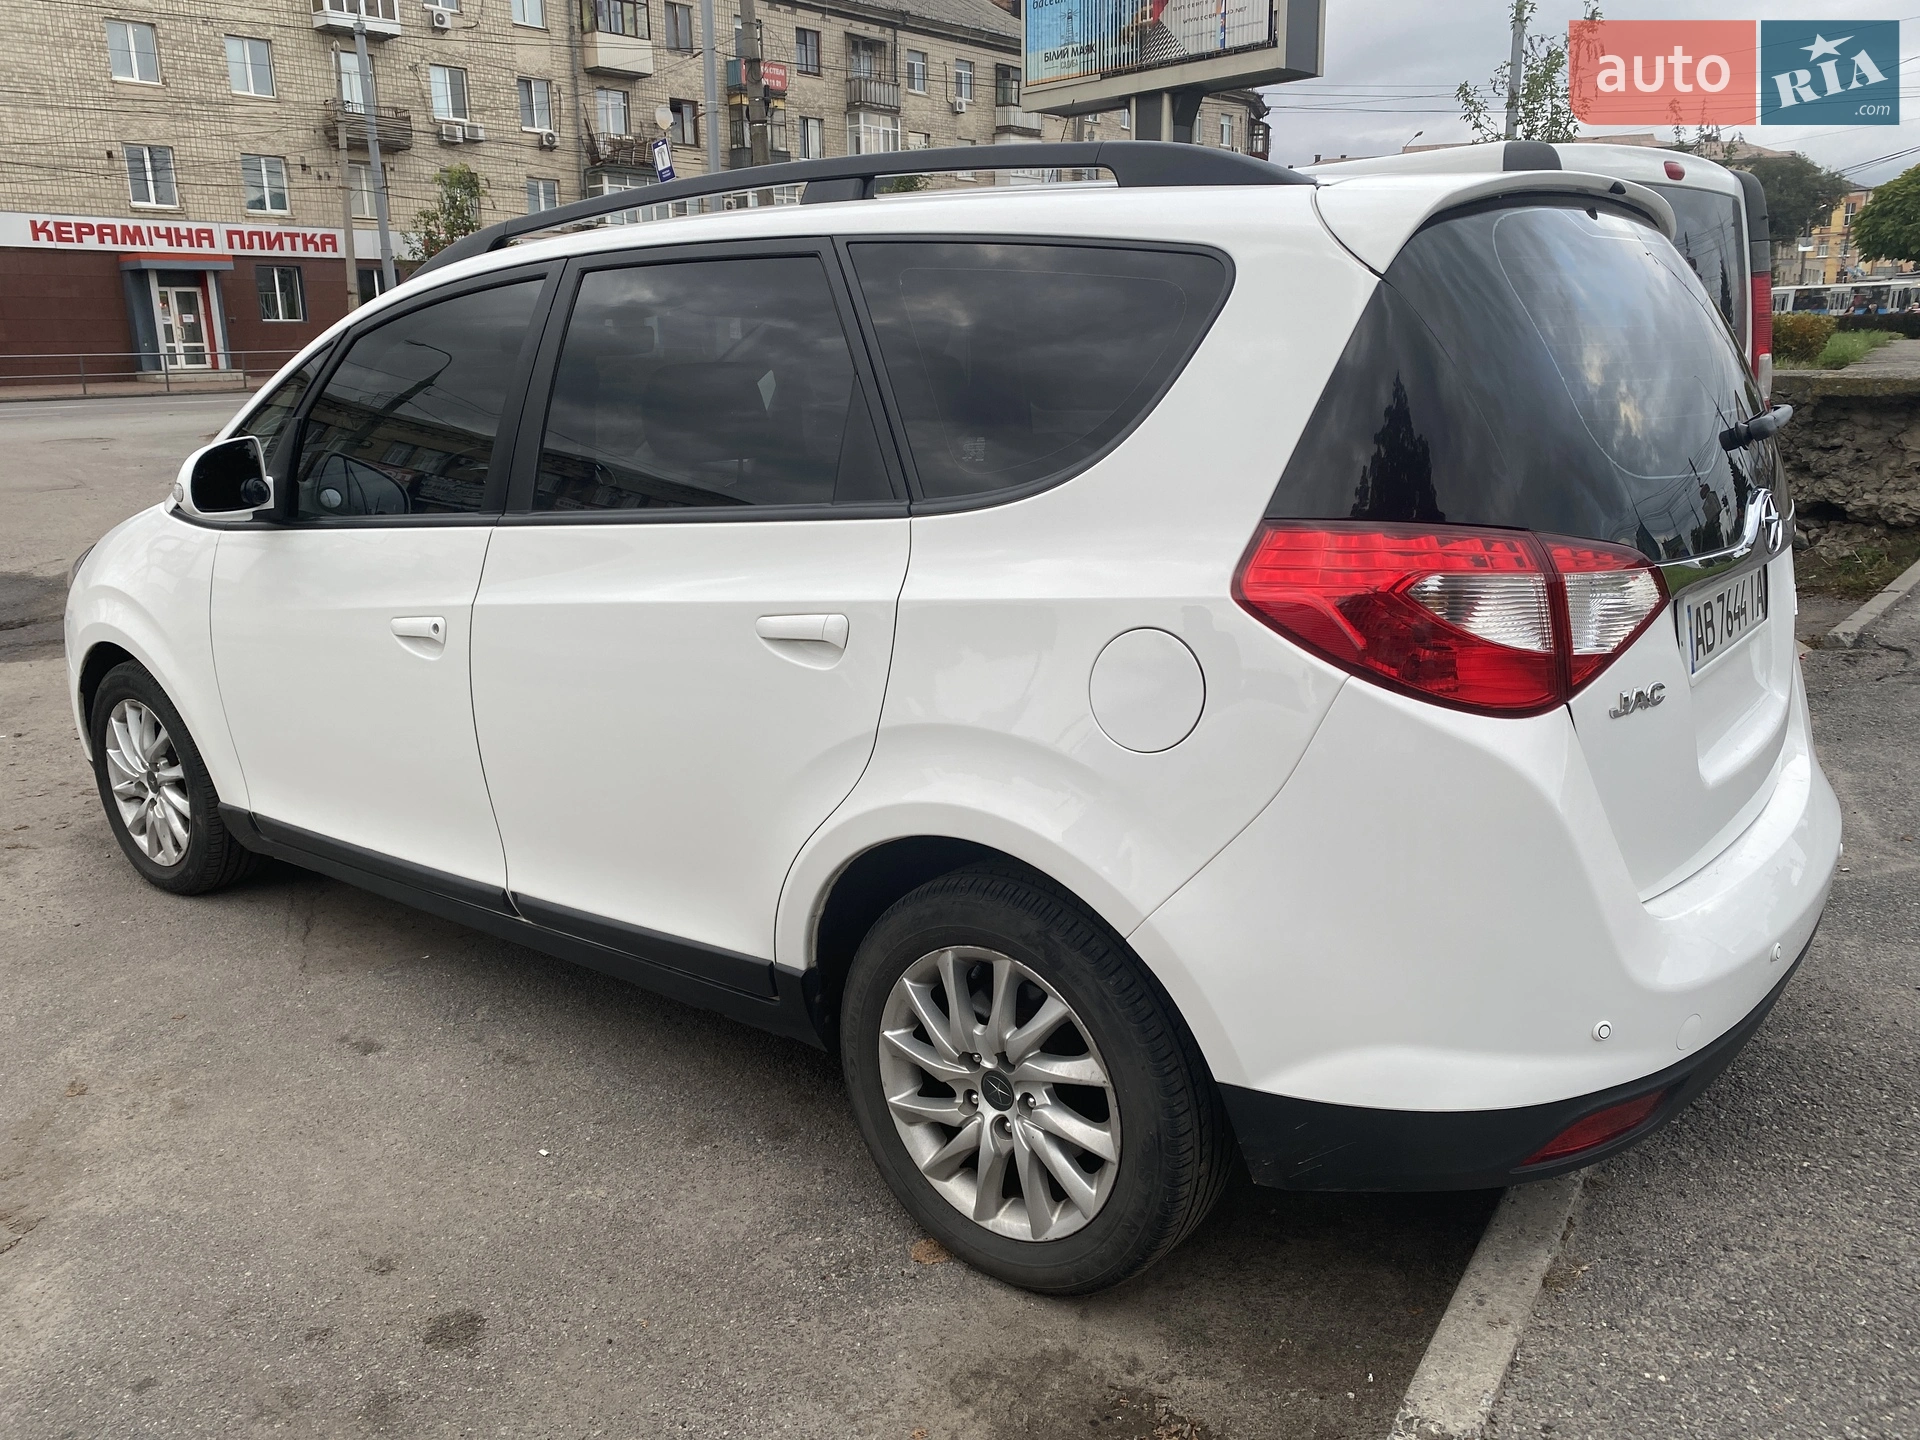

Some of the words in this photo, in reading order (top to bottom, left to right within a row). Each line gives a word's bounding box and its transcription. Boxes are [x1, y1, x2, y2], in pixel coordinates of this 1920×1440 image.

[1044, 46, 1069, 63] БІЛИЙ
[1071, 43, 1096, 58] МАЯК
[29, 219, 216, 250] КЕРАМІЧНА
[226, 229, 338, 254] ПЛИТКА
[1608, 681, 1666, 720] JAC
